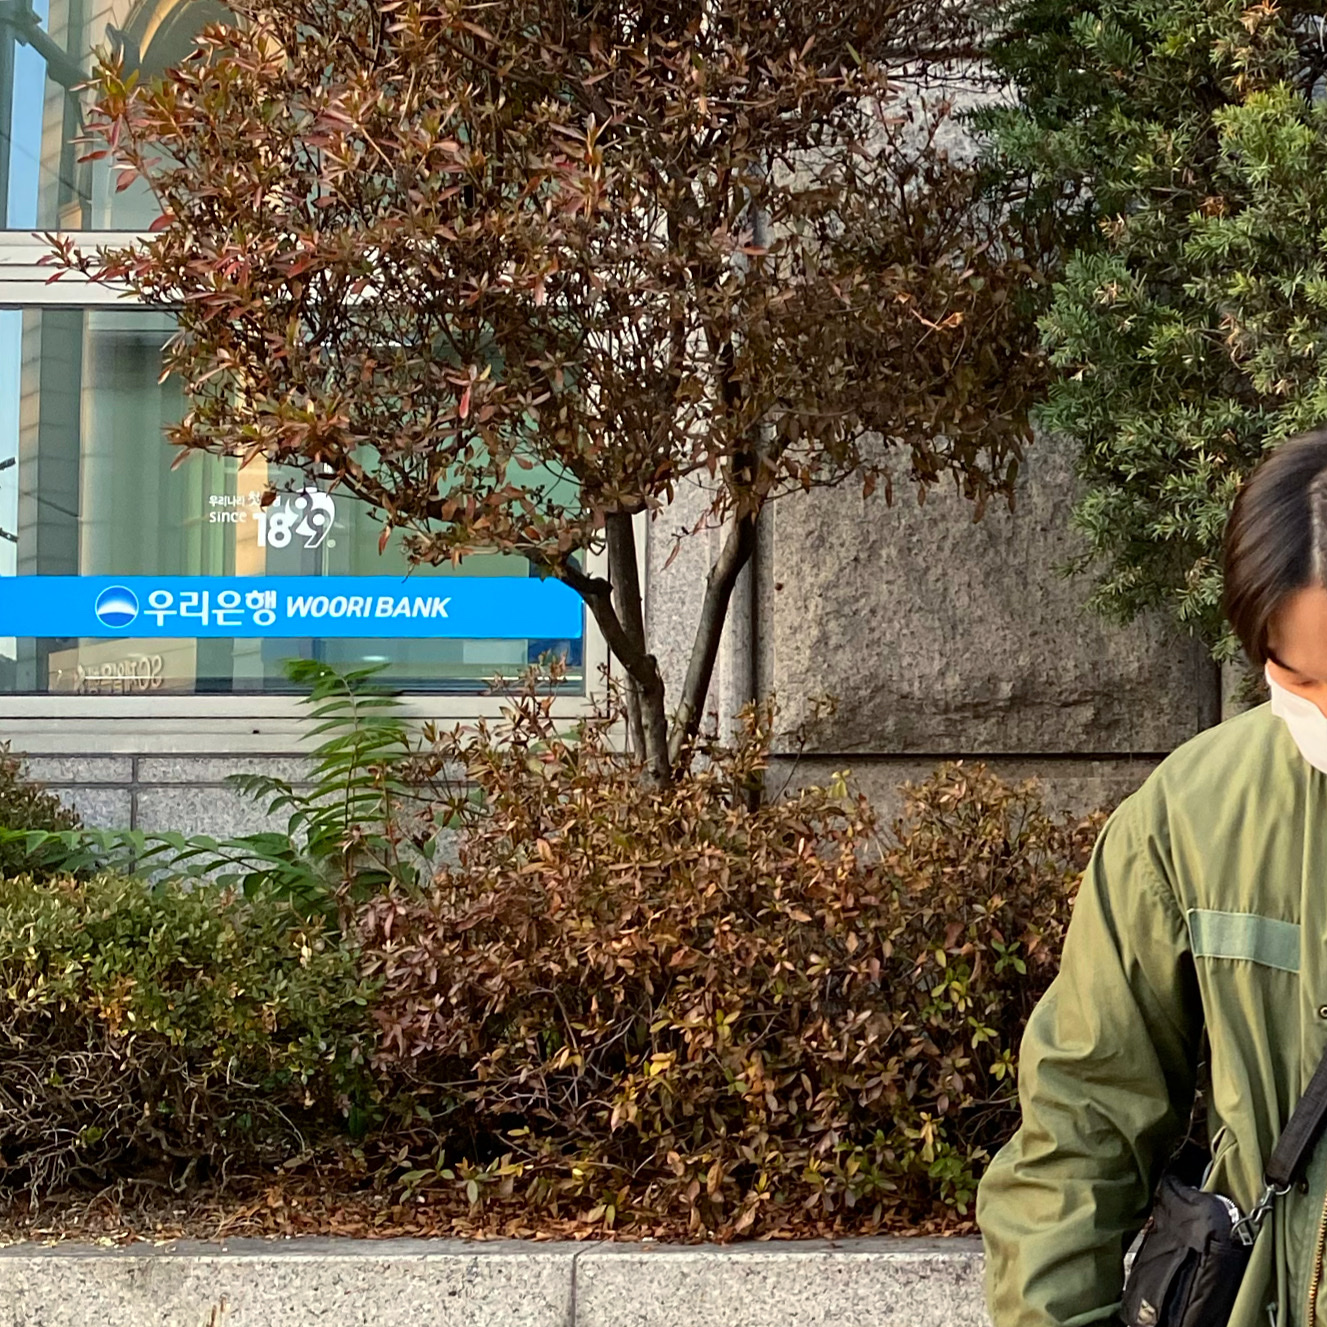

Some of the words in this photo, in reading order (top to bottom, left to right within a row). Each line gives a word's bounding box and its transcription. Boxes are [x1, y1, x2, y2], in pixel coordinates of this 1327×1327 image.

[209, 511, 248, 523] since
[143, 590, 277, 626] 우리은행
[286, 596, 373, 618] WOORI
[374, 597, 452, 618] BANK
